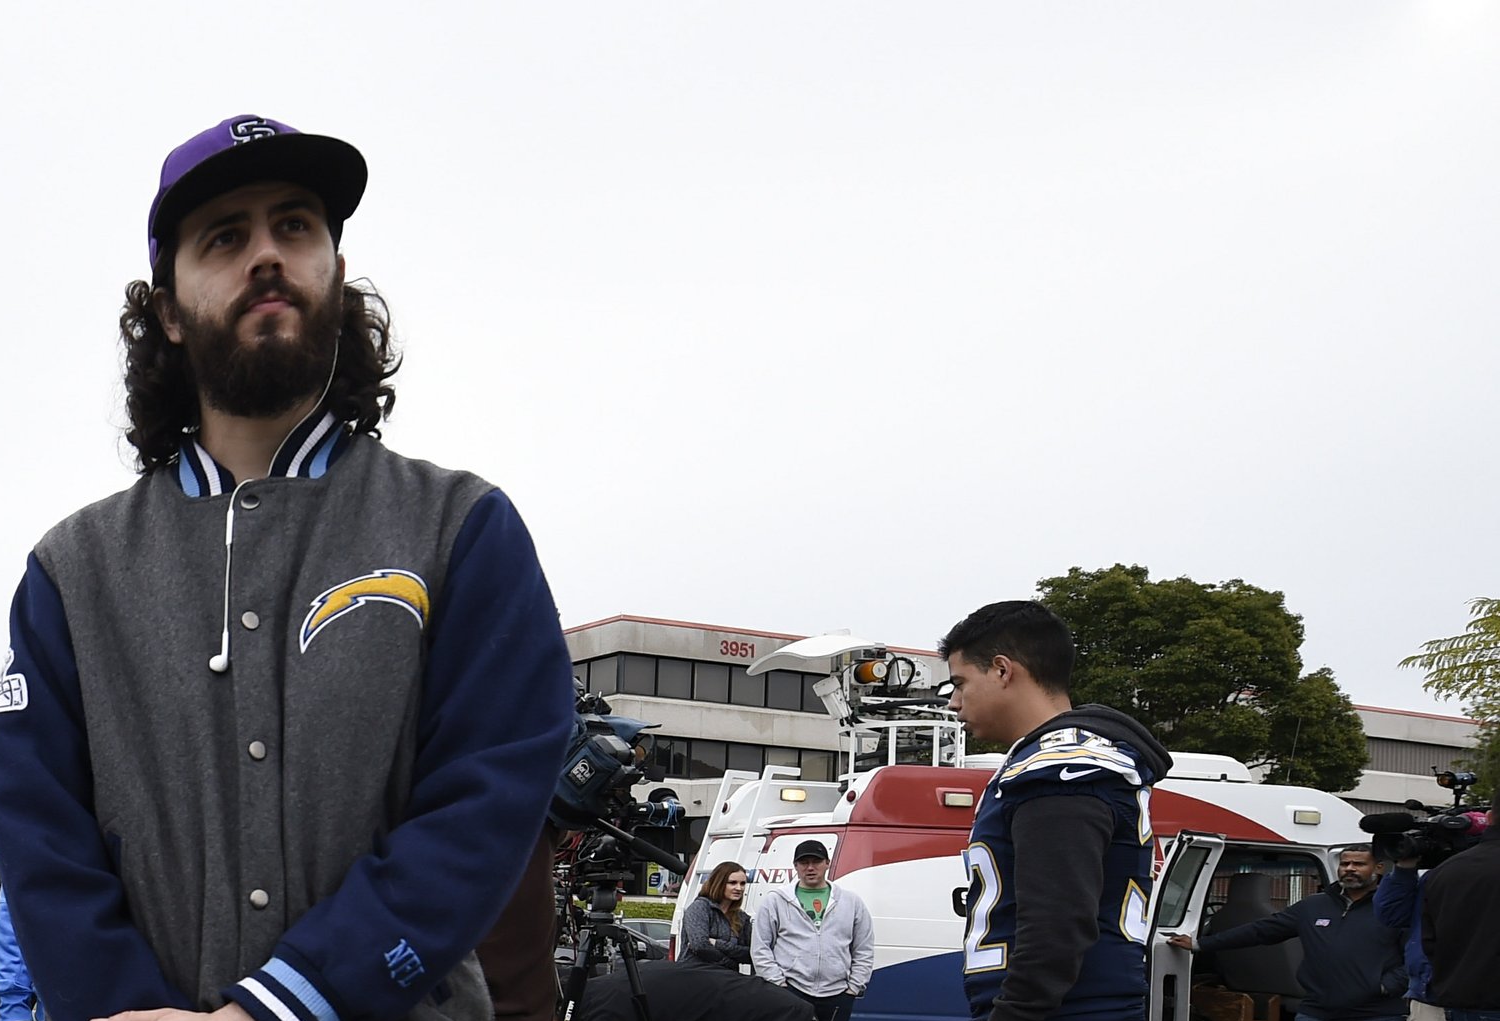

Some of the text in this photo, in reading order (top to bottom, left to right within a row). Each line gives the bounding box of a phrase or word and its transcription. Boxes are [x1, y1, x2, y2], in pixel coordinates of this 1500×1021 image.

[719, 640, 756, 659] 3951
[753, 868, 801, 884] NEW
[961, 841, 1008, 975] 2
[383, 938, 425, 988] NFL
